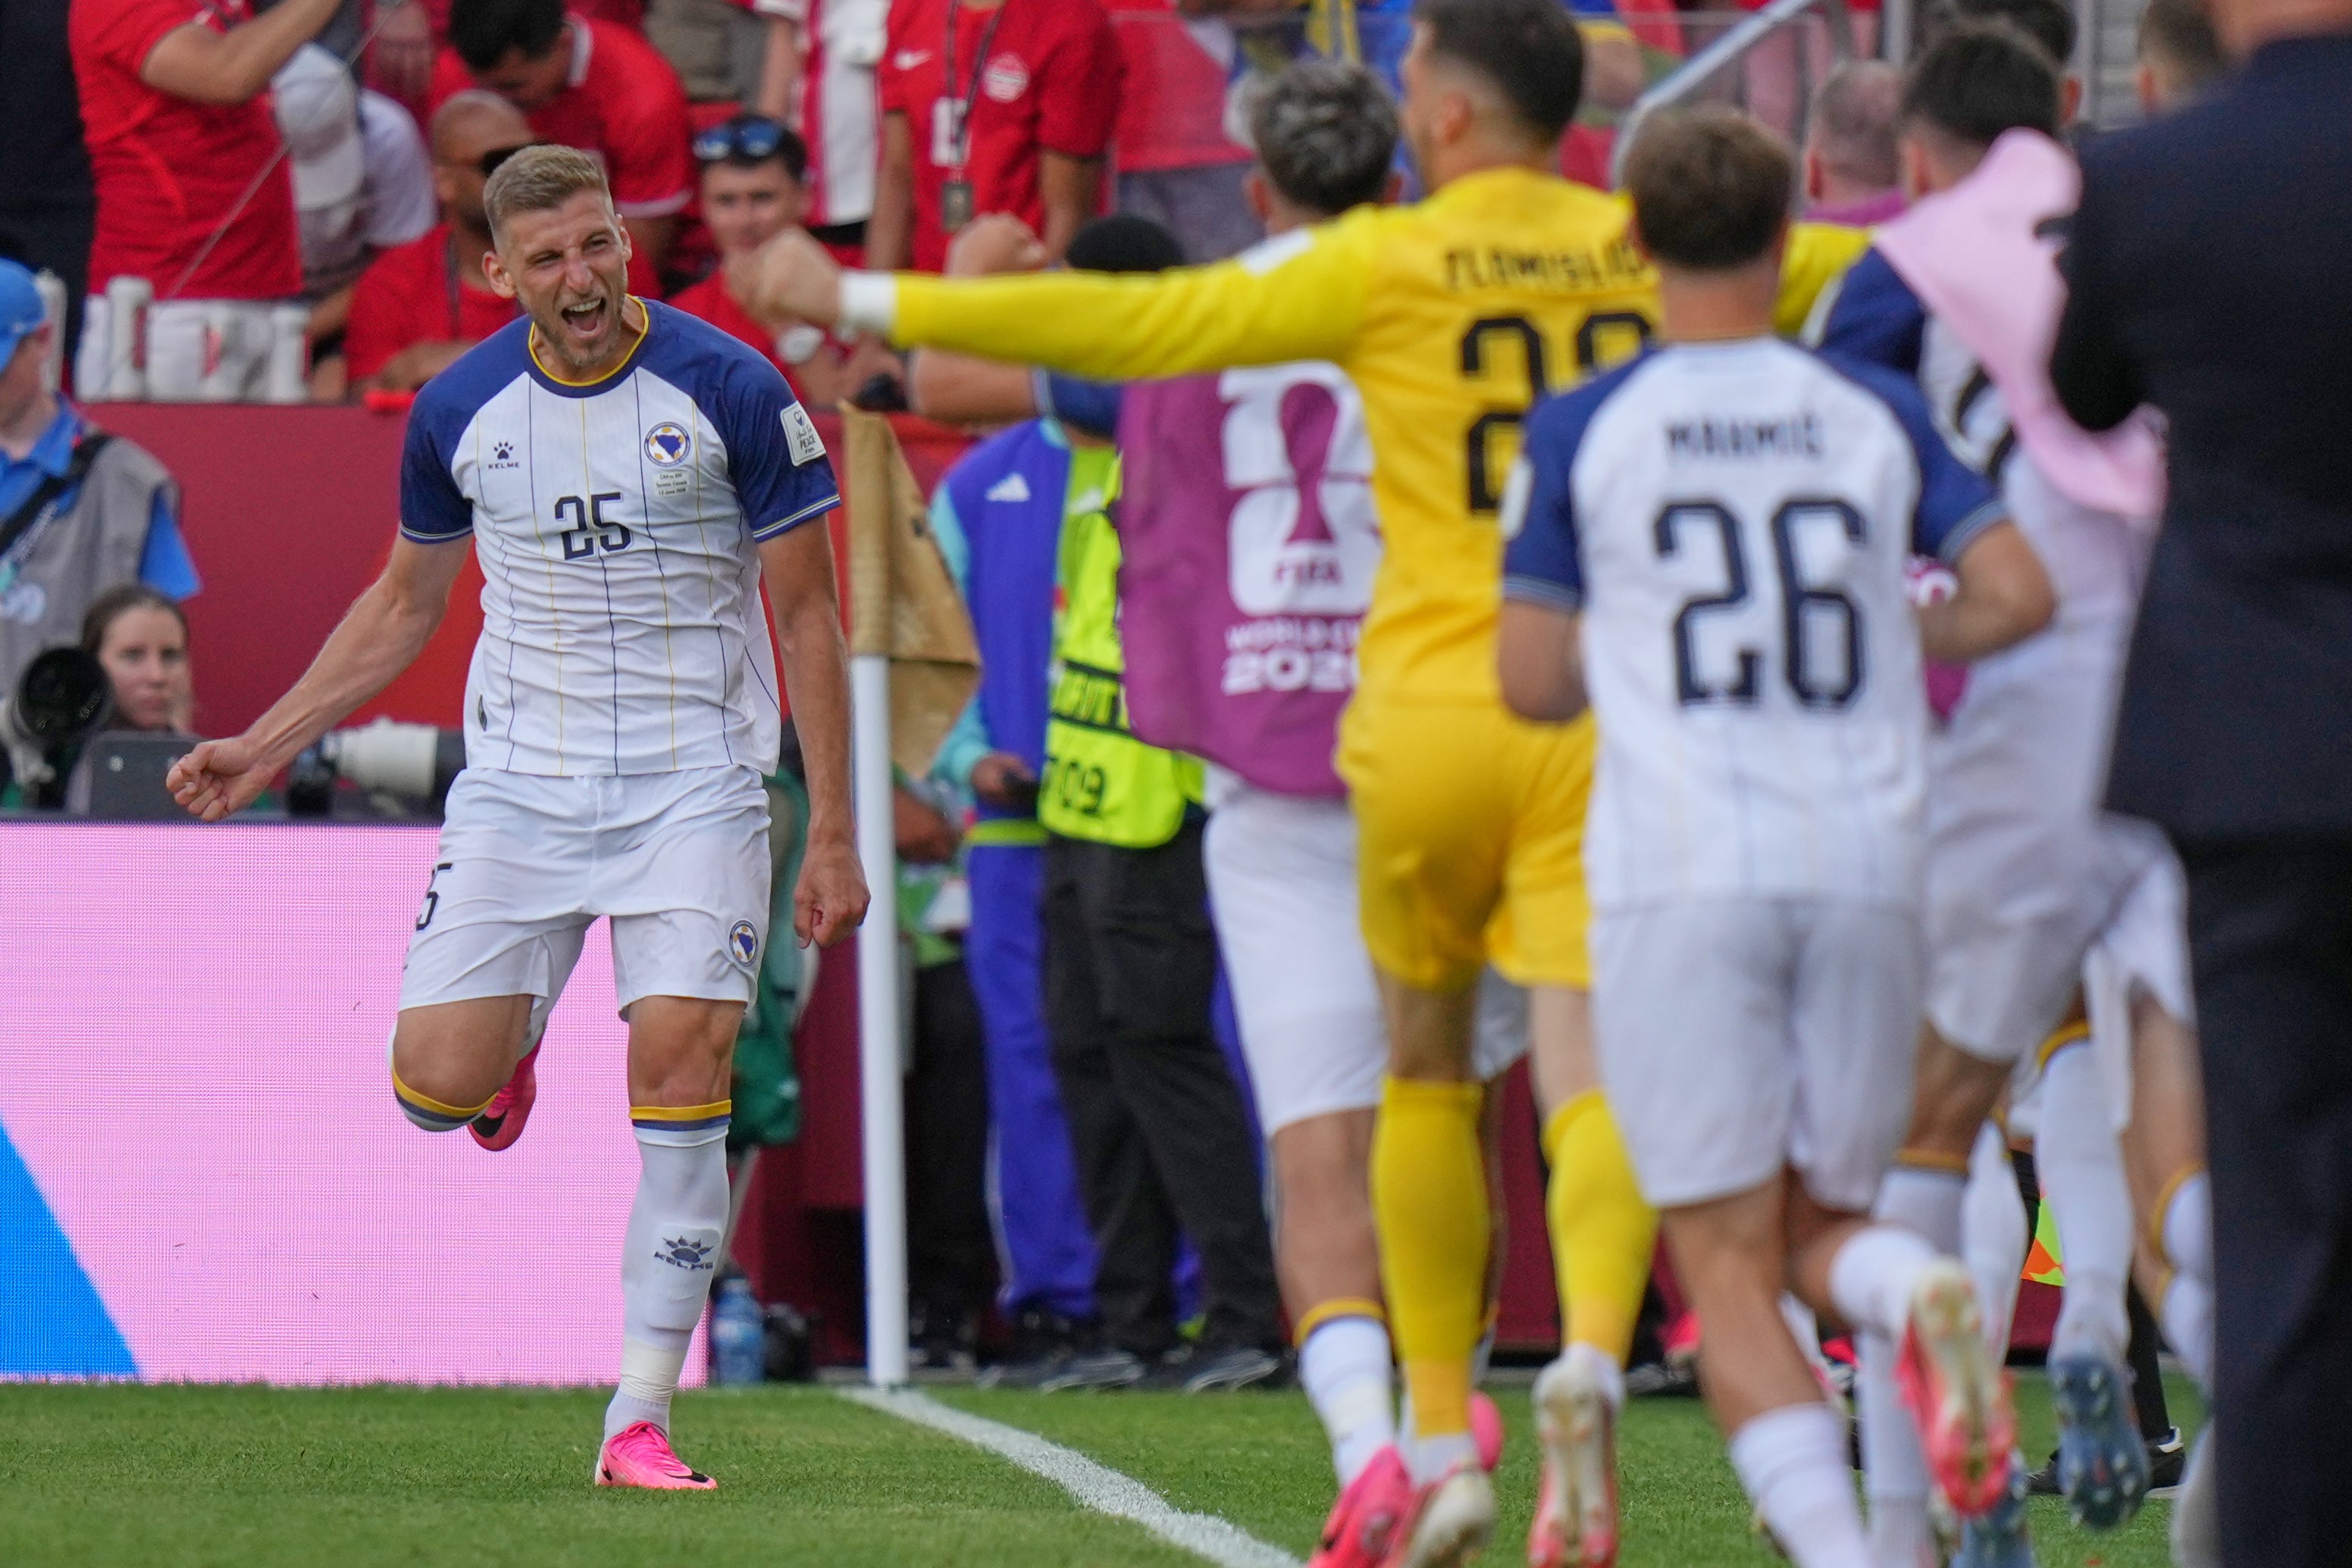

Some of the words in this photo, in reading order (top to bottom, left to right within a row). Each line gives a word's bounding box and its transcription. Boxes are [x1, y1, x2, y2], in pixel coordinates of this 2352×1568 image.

[1462, 312, 1652, 511] 2
[800, 434, 816, 450] PEACE
[554, 492, 633, 561] 25
[1273, 559, 1342, 586] FIFA
[1653, 499, 1866, 707] 26
[654, 1251, 713, 1270] KELME
